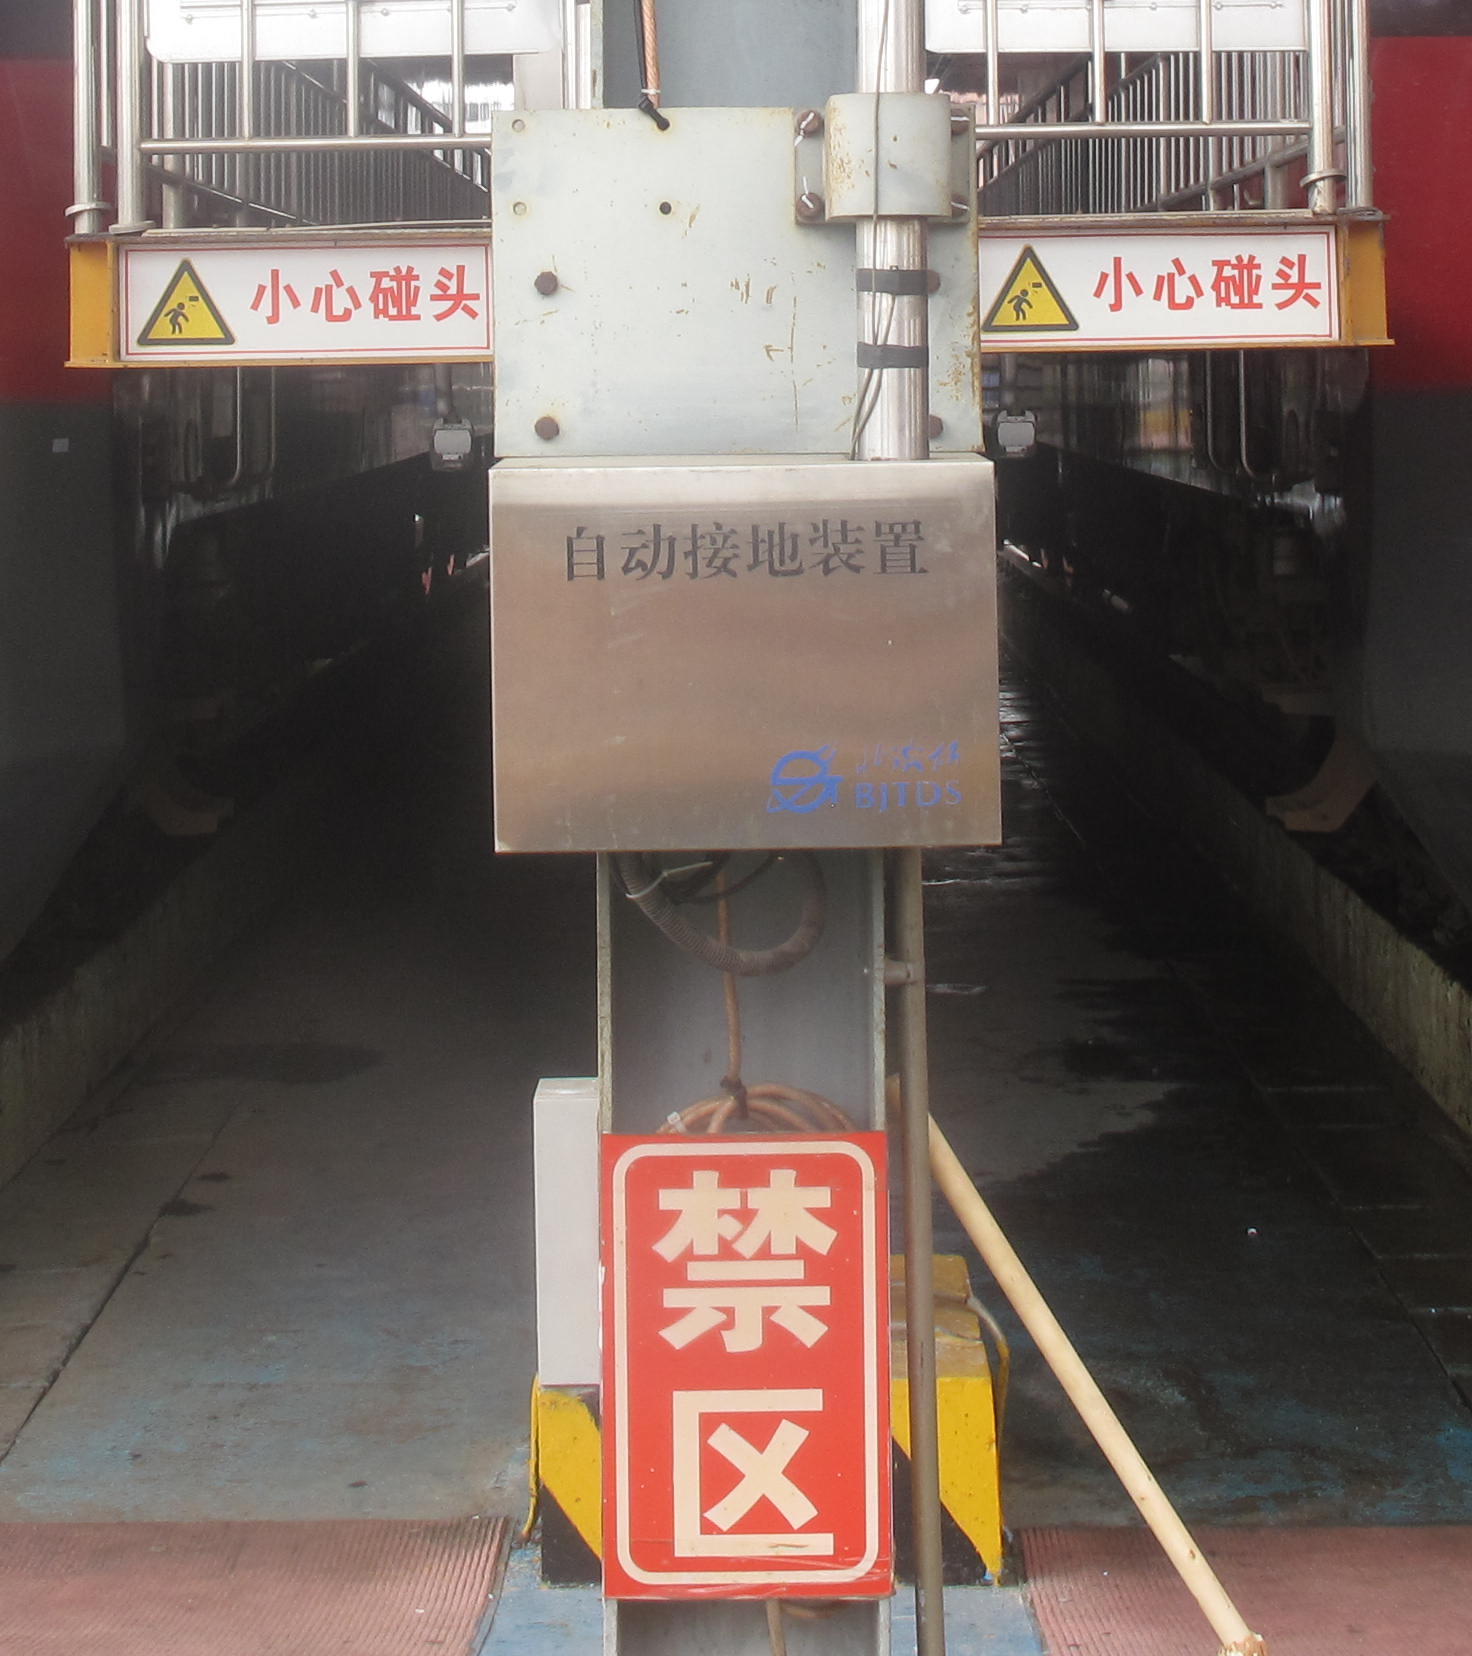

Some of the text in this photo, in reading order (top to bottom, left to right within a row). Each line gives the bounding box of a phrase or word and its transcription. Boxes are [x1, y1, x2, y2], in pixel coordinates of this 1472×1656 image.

[249, 264, 481, 325] 小心碰头
[1092, 254, 1322, 313] 小心碰头
[564, 519, 929, 583] 自动接地装置
[651, 1168, 838, 1558] 禁区
